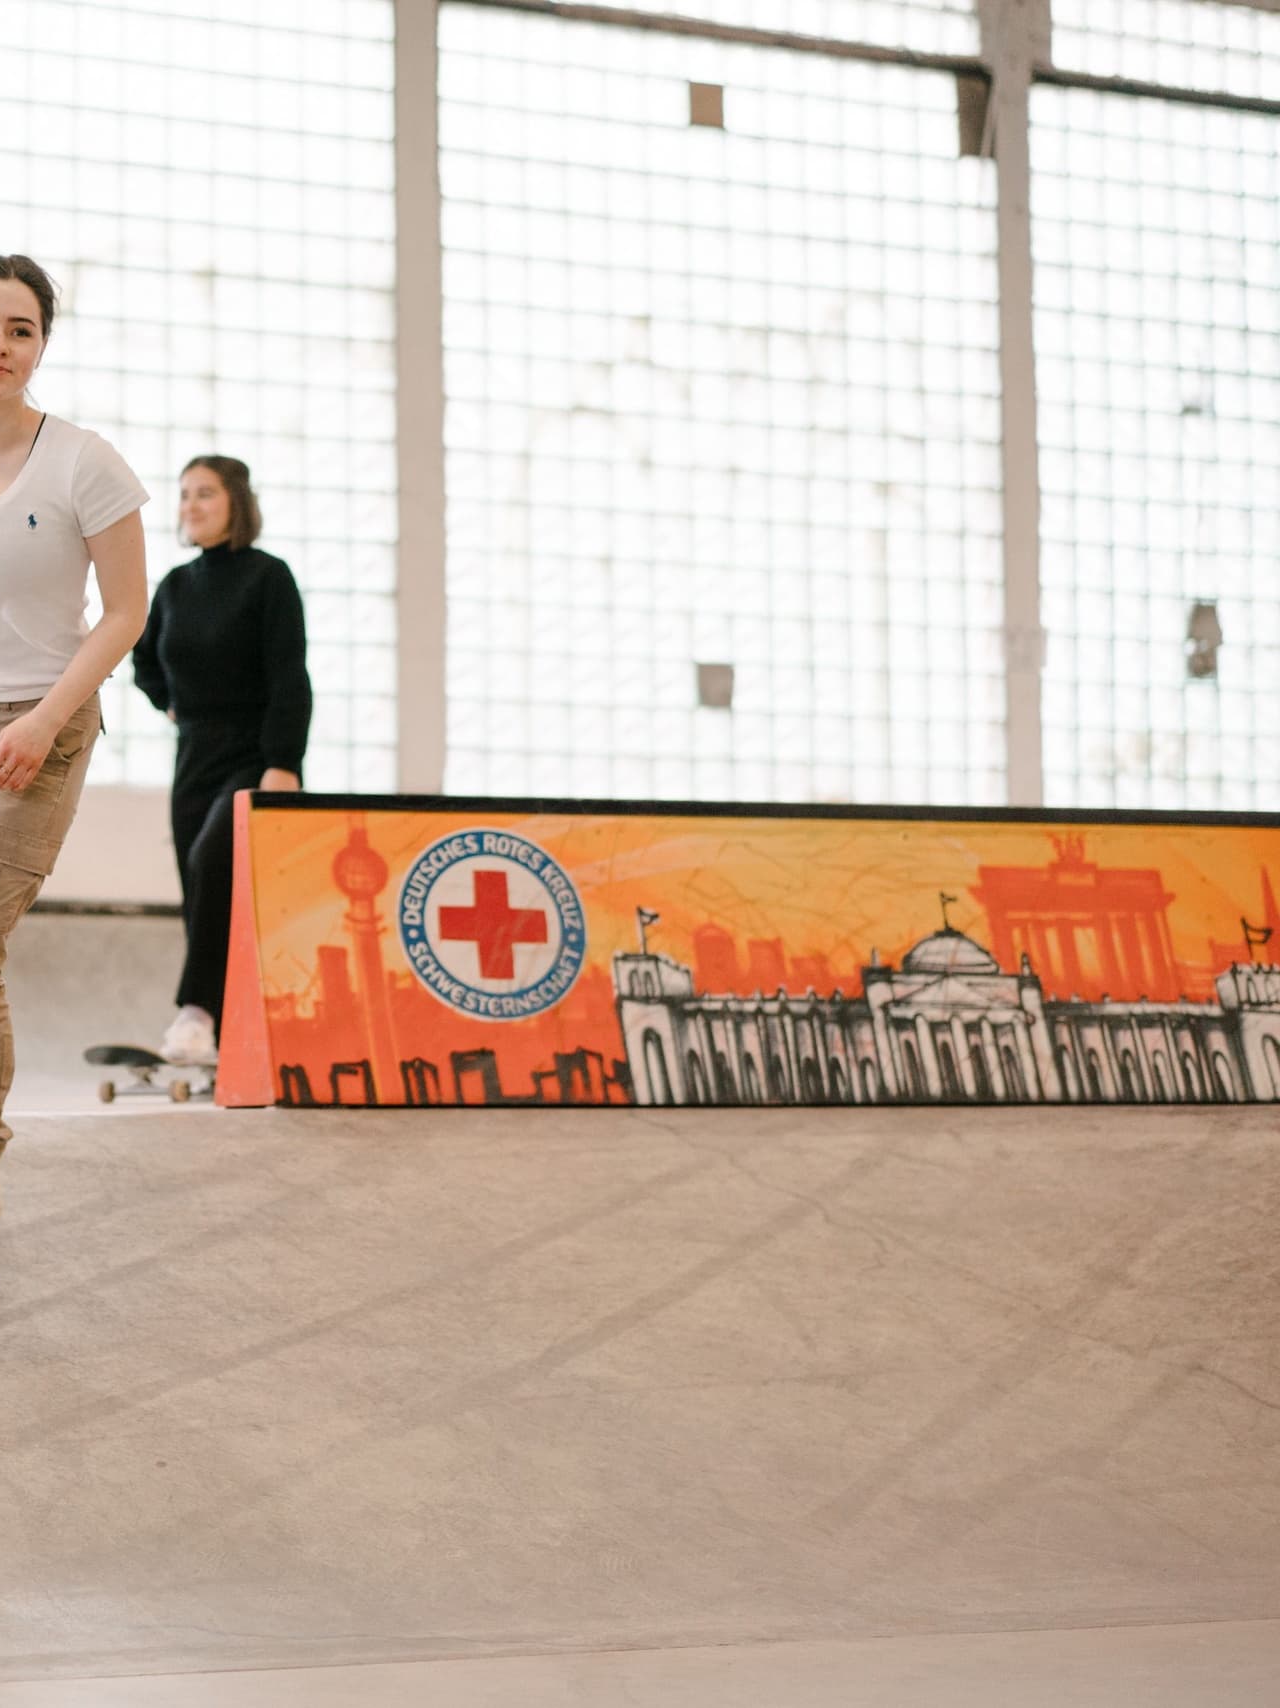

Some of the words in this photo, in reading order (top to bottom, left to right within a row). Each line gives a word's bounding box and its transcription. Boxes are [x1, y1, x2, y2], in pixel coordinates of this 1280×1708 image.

[403, 833, 478, 925] DEUTSCHES
[483, 833, 544, 871] ROTES
[539, 863, 582, 930] KREUZ
[408, 942, 580, 1016] SCHWESTERNSCHAFT
